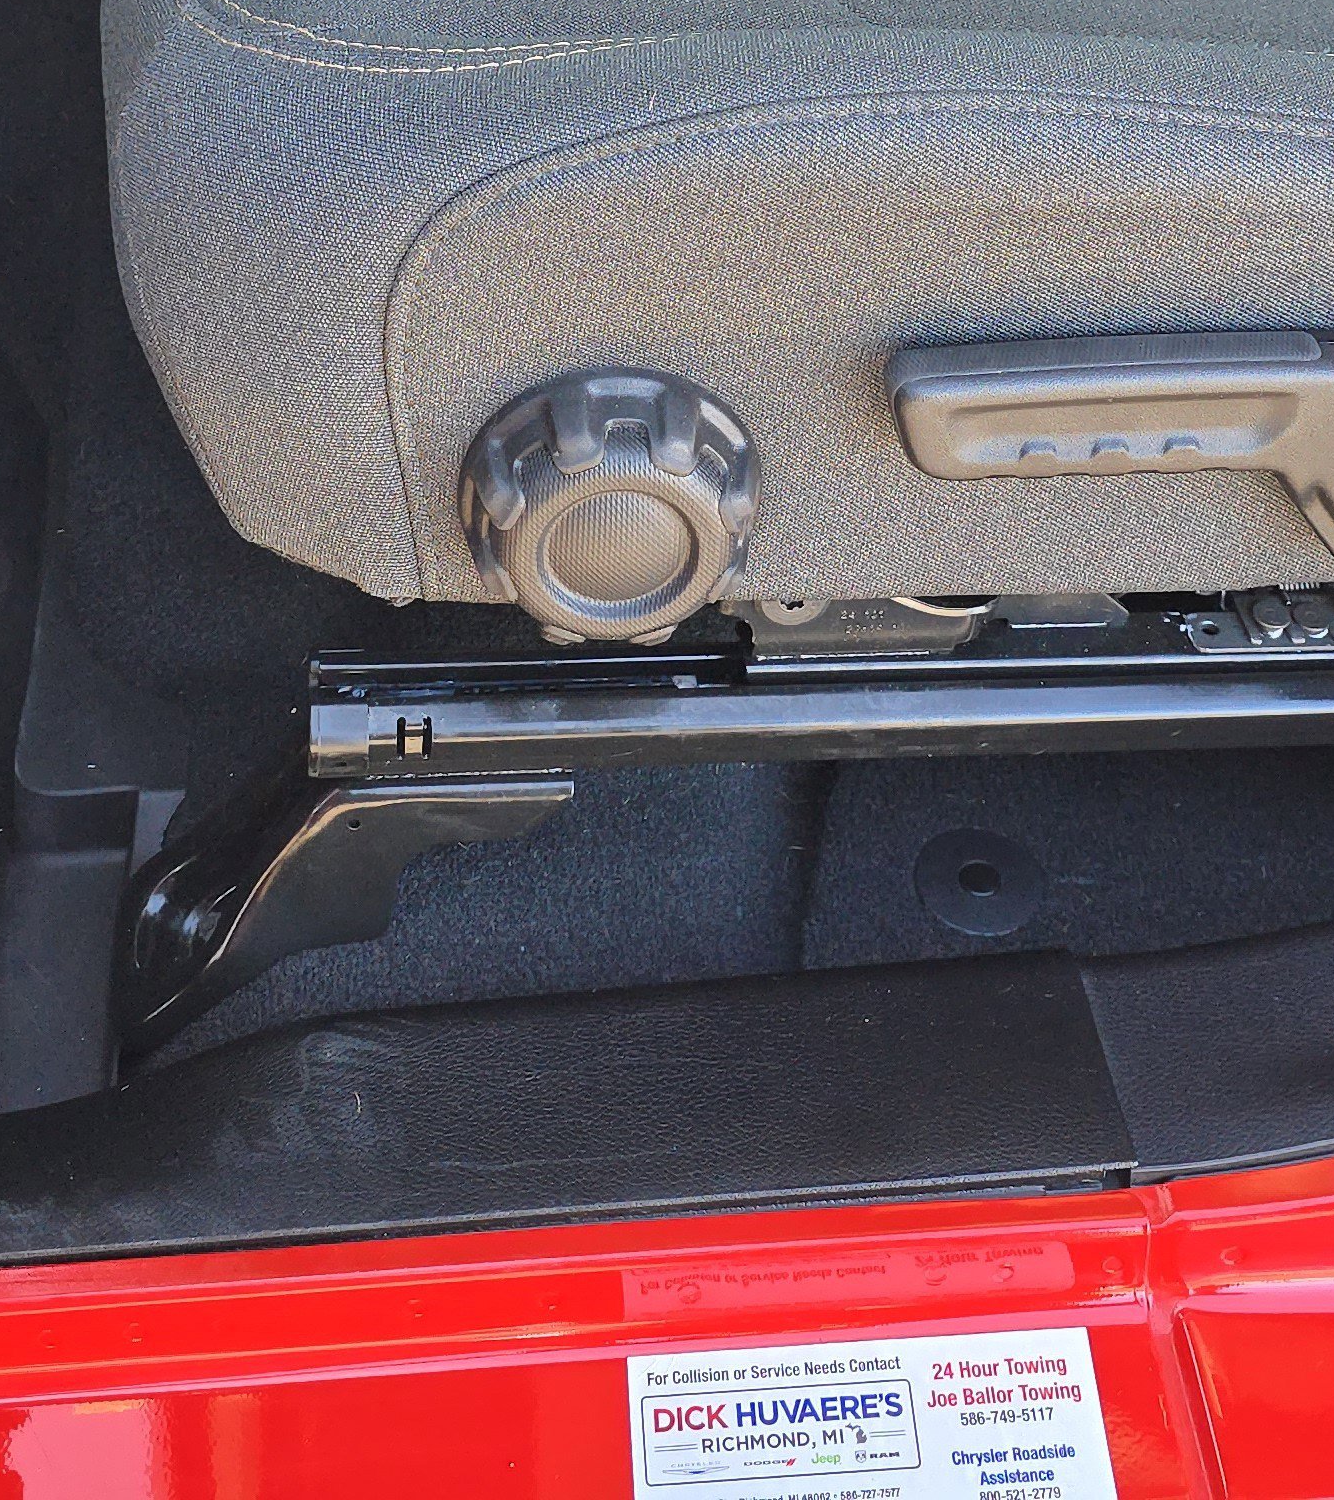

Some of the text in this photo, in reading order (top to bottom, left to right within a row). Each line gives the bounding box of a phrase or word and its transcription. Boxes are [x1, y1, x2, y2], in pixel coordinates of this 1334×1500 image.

[647, 1356, 901, 1386] For Collision or Service Needs Contact
[932, 1356, 1067, 1380] 24 Hour Towing
[927, 1382, 1082, 1408] Joe Ballor Towing
[654, 1392, 903, 1433] DICK HUVAERE'S
[960, 1406, 1054, 1426] 586-749-5117
[701, 1428, 845, 1454] RICHMOND, MI
[743, 1459, 787, 1467] DODGE
[811, 1452, 841, 1465] Jeep
[869, 1451, 900, 1460] RAM
[952, 1443, 1075, 1467] Chrysler Roadside
[980, 1468, 1055, 1486] Assistance
[979, 1486, 1062, 1500] 800-521-2779
